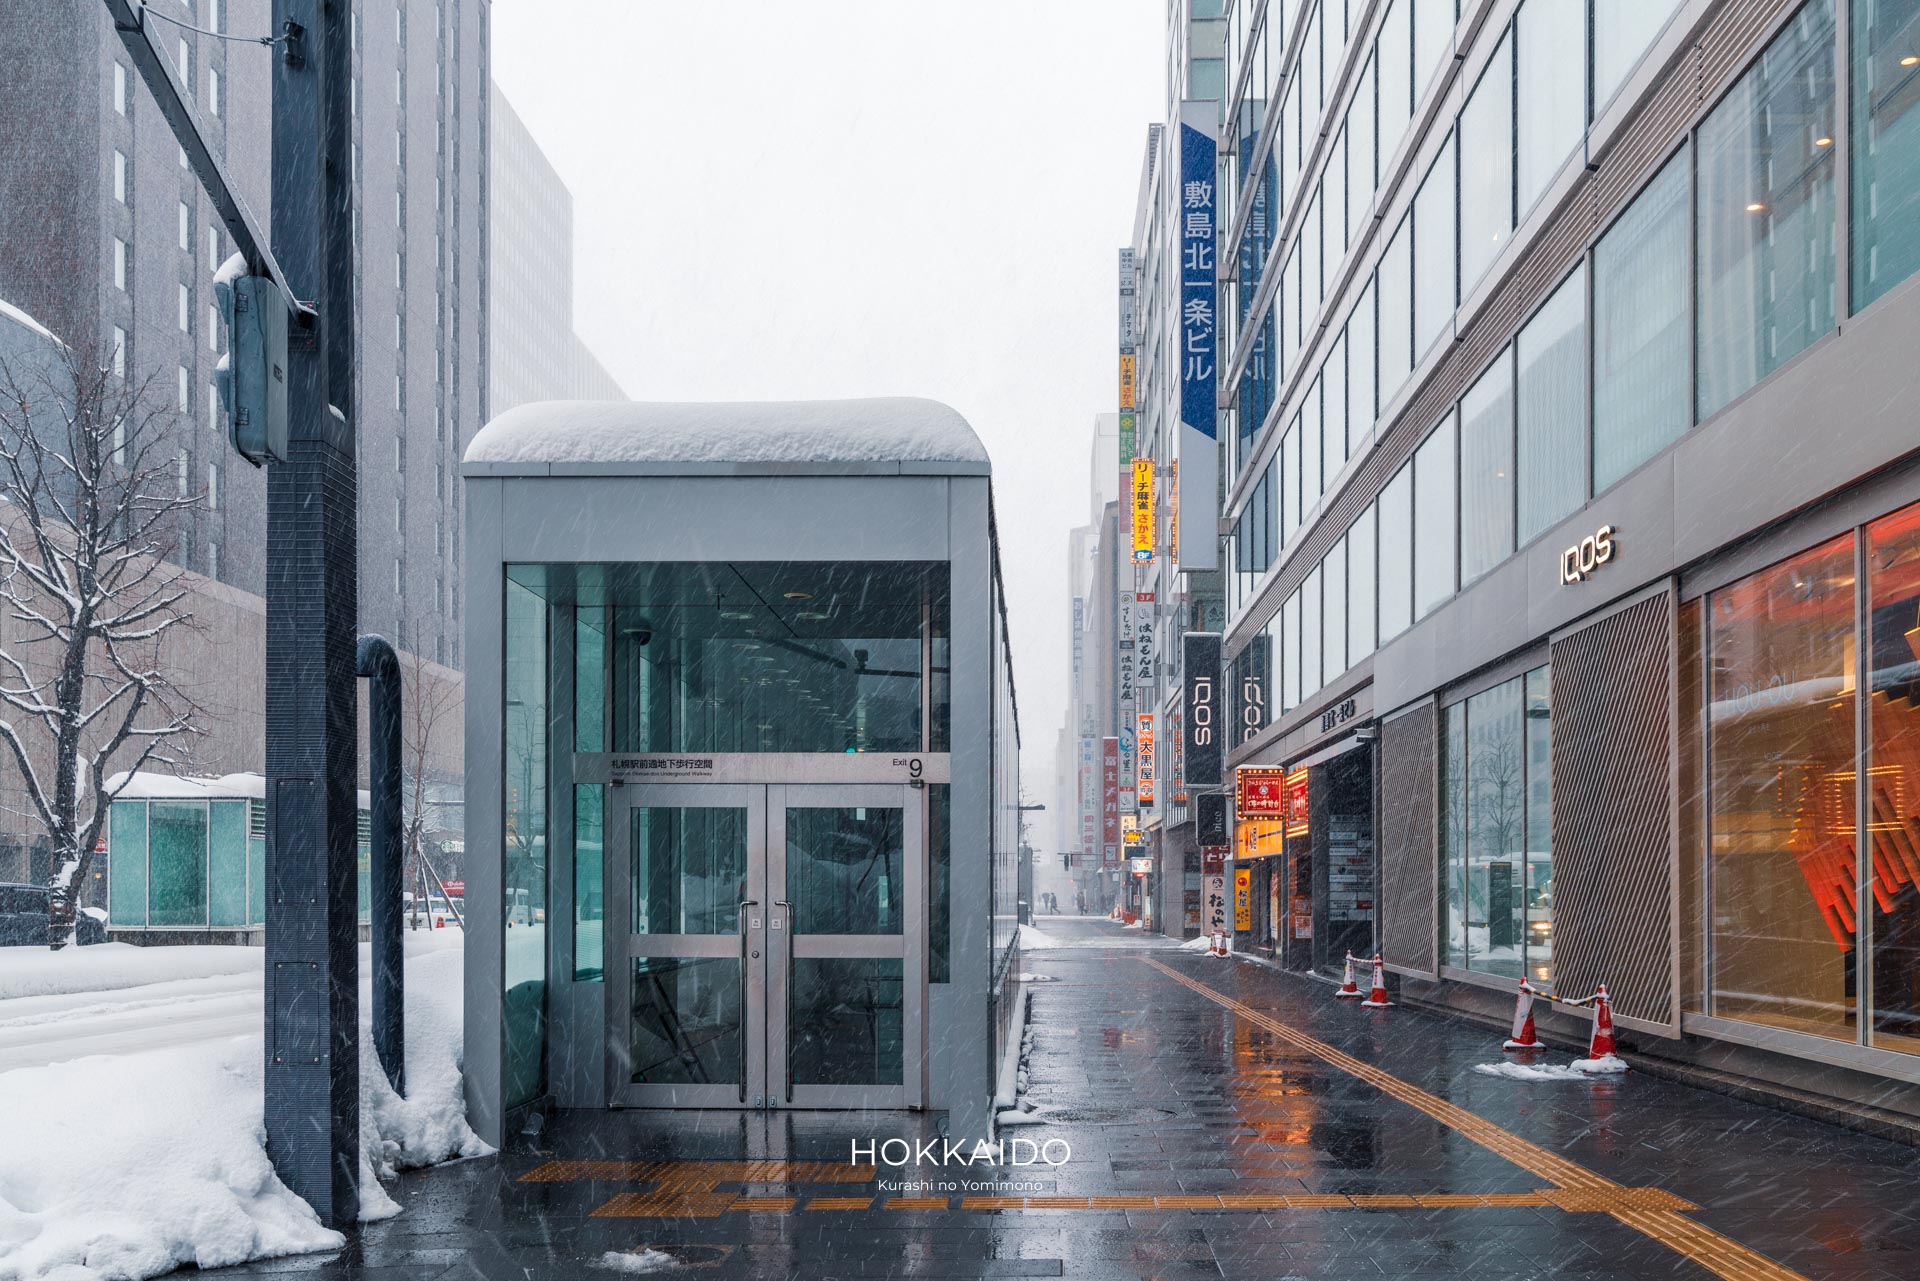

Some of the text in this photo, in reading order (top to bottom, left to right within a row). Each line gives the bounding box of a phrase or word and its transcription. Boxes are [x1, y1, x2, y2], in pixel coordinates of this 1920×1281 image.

[1184, 180, 1212, 382] 敷島北一条ビル
[1137, 463, 1149, 545] リーチ麻雀 さかえ
[1137, 551, 1150, 559] 8F
[1561, 525, 1615, 586] IQOS
[1121, 606, 1132, 639] すしたけ
[1138, 623, 1153, 678] はねもん屋
[1121, 655, 1133, 700] はねもん屋
[1193, 676, 1211, 746] IQOS
[611, 759, 713, 769] 札幌駅前通地下歩行空間
[892, 758, 907, 766] Exit
[910, 758, 923, 777] 9
[1140, 741, 1153, 780] 大黒屋
[1104, 756, 1117, 828] 富士メガネ
[1238, 889, 1248, 906] 松屋
